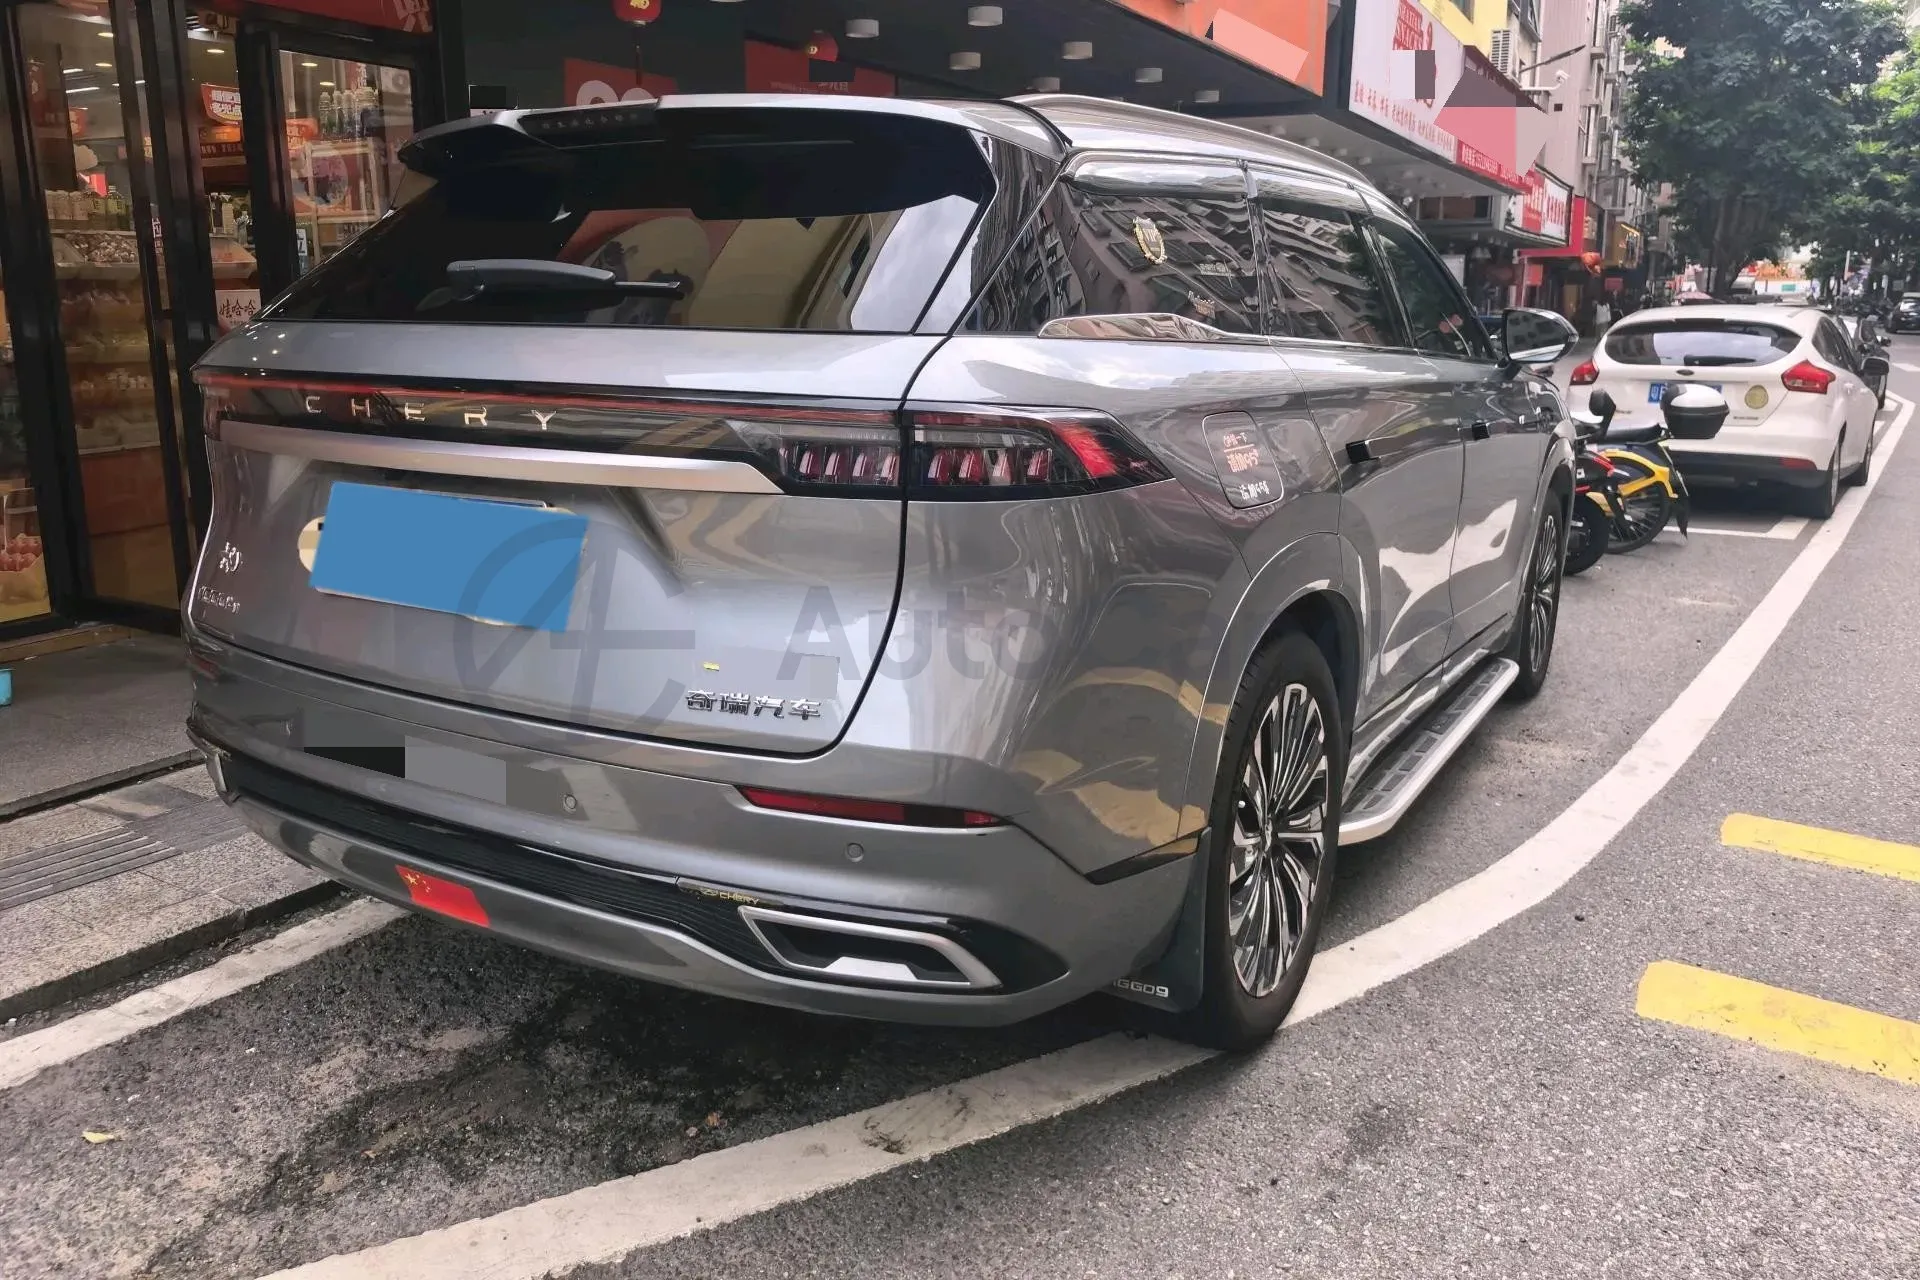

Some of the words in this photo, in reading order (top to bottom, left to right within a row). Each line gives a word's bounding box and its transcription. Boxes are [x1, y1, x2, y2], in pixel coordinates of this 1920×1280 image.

[219, 299, 256, 318] 娃哈哈
[305, 395, 557, 431] CHERY
[685, 690, 821, 720] 奇瑞汽车
[719, 891, 760, 905] CHERY
